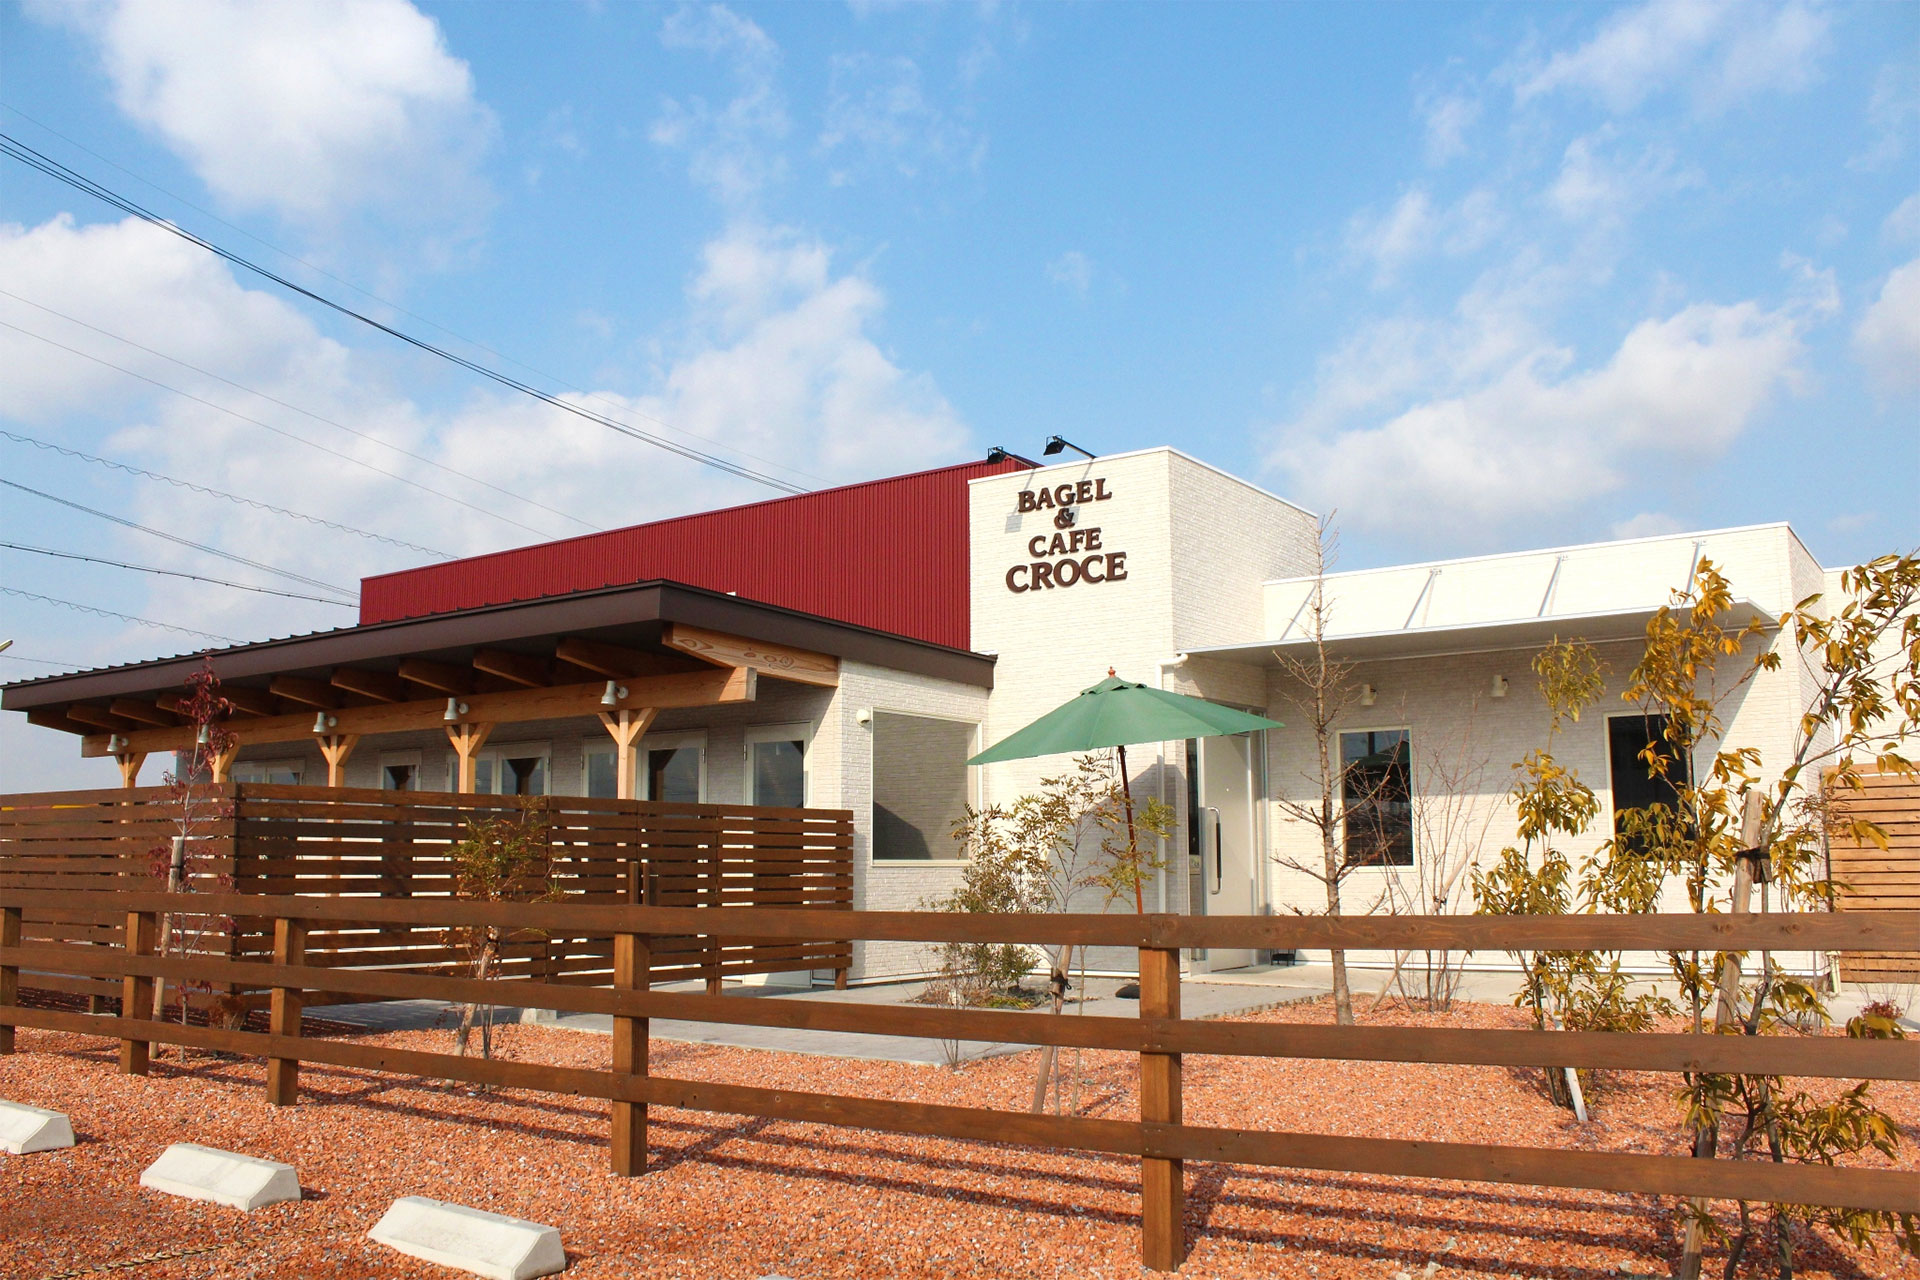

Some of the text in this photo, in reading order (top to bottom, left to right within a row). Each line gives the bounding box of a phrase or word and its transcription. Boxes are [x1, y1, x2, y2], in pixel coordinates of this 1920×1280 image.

[1018, 478, 1112, 513] BAGEL
[1053, 507, 1075, 529] &
[1028, 527, 1103, 558] CAFE
[1005, 551, 1128, 593] CROCE
